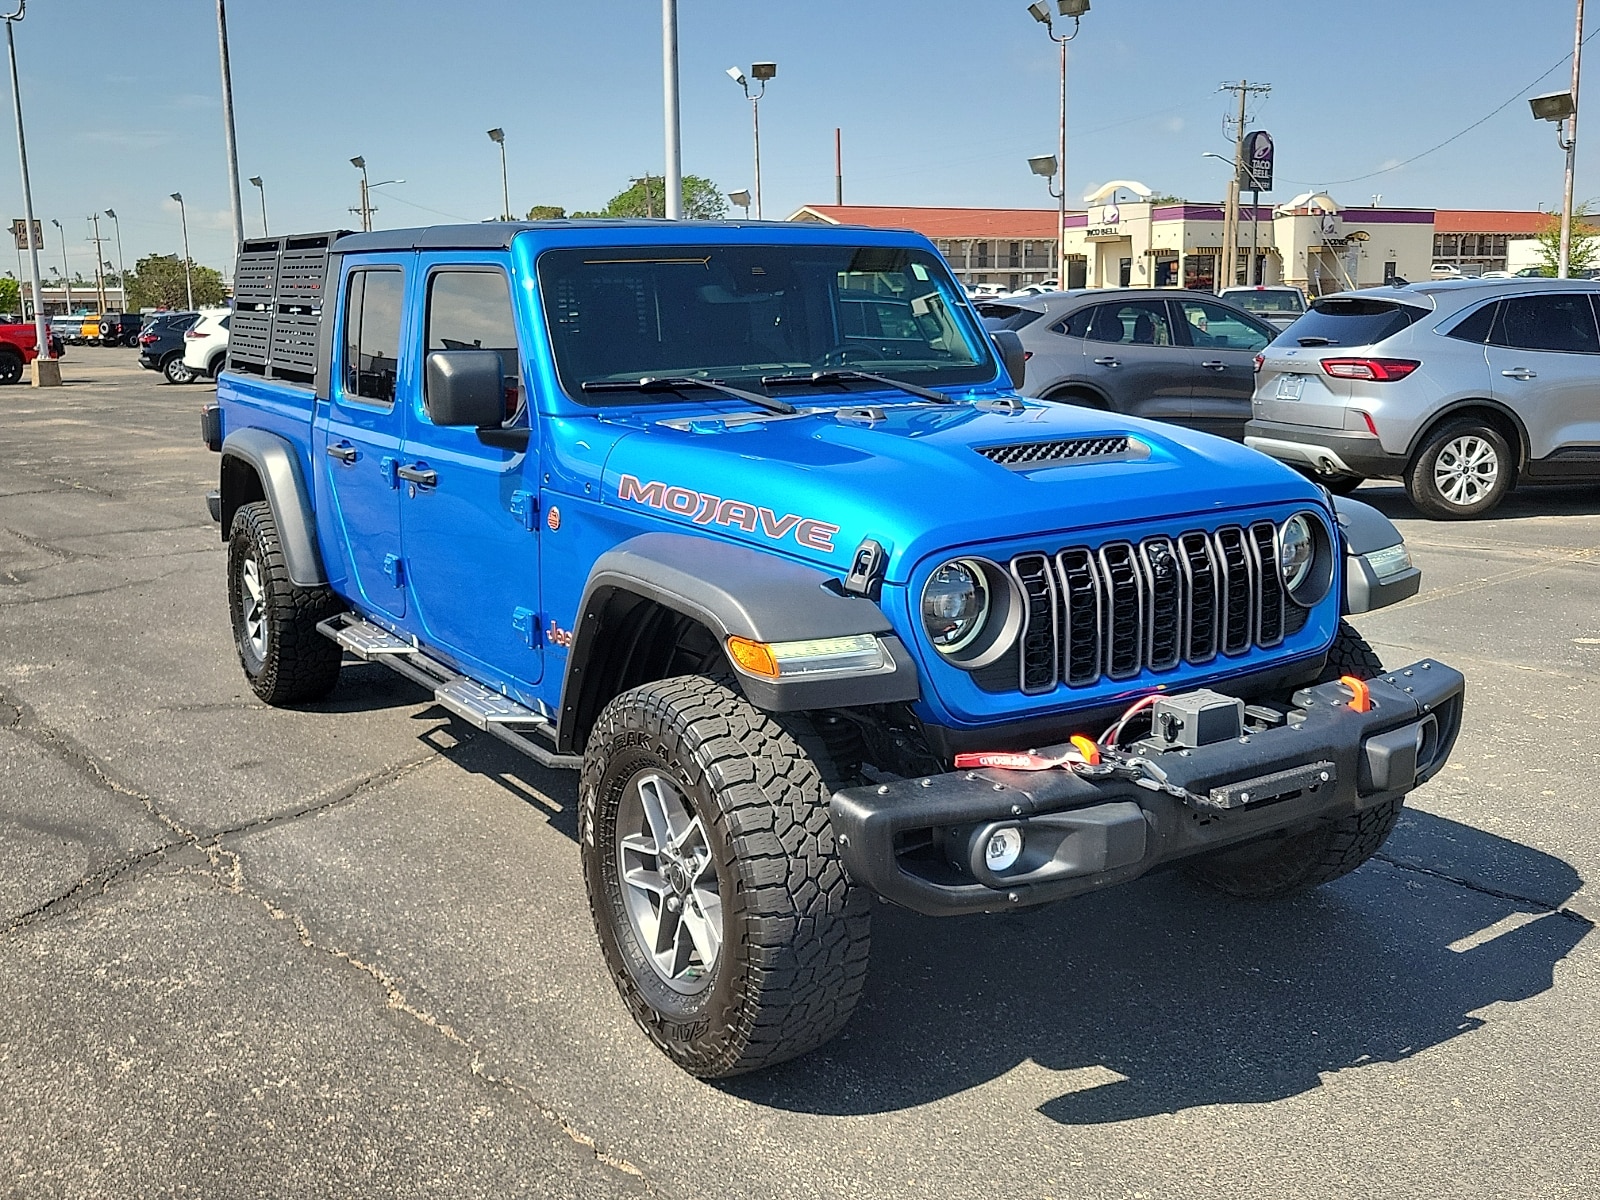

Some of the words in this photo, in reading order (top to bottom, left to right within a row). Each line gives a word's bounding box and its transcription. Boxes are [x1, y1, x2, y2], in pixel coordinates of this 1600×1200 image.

[1252, 160, 1270, 169] TACO
[1253, 169, 1270, 178] BELL
[1101, 227, 1119, 235] BELL
[618, 474, 840, 552] MOJAVE
[546, 620, 572, 647] Jee
[979, 756, 1030, 767] OPENROAD
